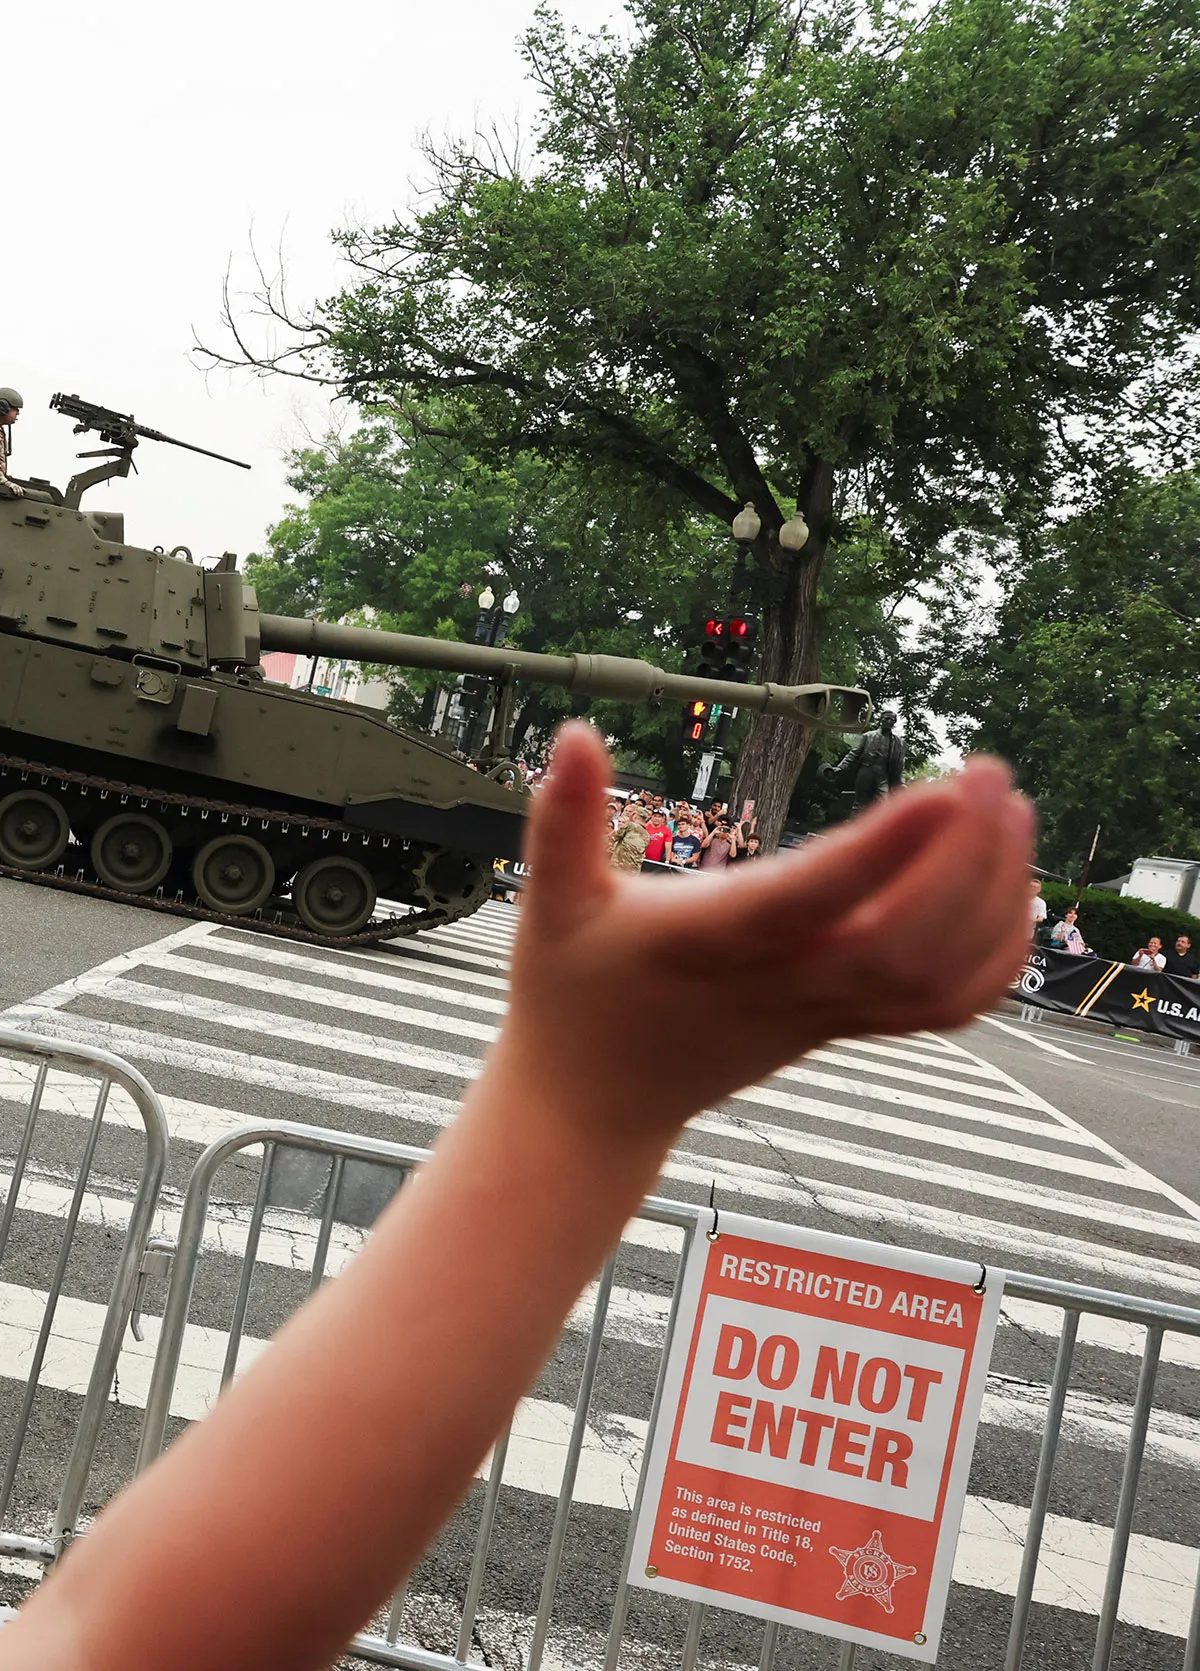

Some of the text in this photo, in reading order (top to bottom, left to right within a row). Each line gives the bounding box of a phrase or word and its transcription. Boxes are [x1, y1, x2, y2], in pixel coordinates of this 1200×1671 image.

[1157, 999, 1184, 1018] U.S.
[720, 1253, 964, 1329] RESTRICTED AREA
[712, 1324, 943, 1423] DO NOT
[710, 1390, 914, 1489] ENTER
[671, 1506, 814, 1552] as defined in Title 18,
[676, 1486, 822, 1533] This area is restricted
[665, 1539, 753, 1573] Section 1752.
[668, 1521, 798, 1567] United States Code,
[853, 1549, 892, 1565] SECRET
[848, 1574, 889, 1593] SERVICE
